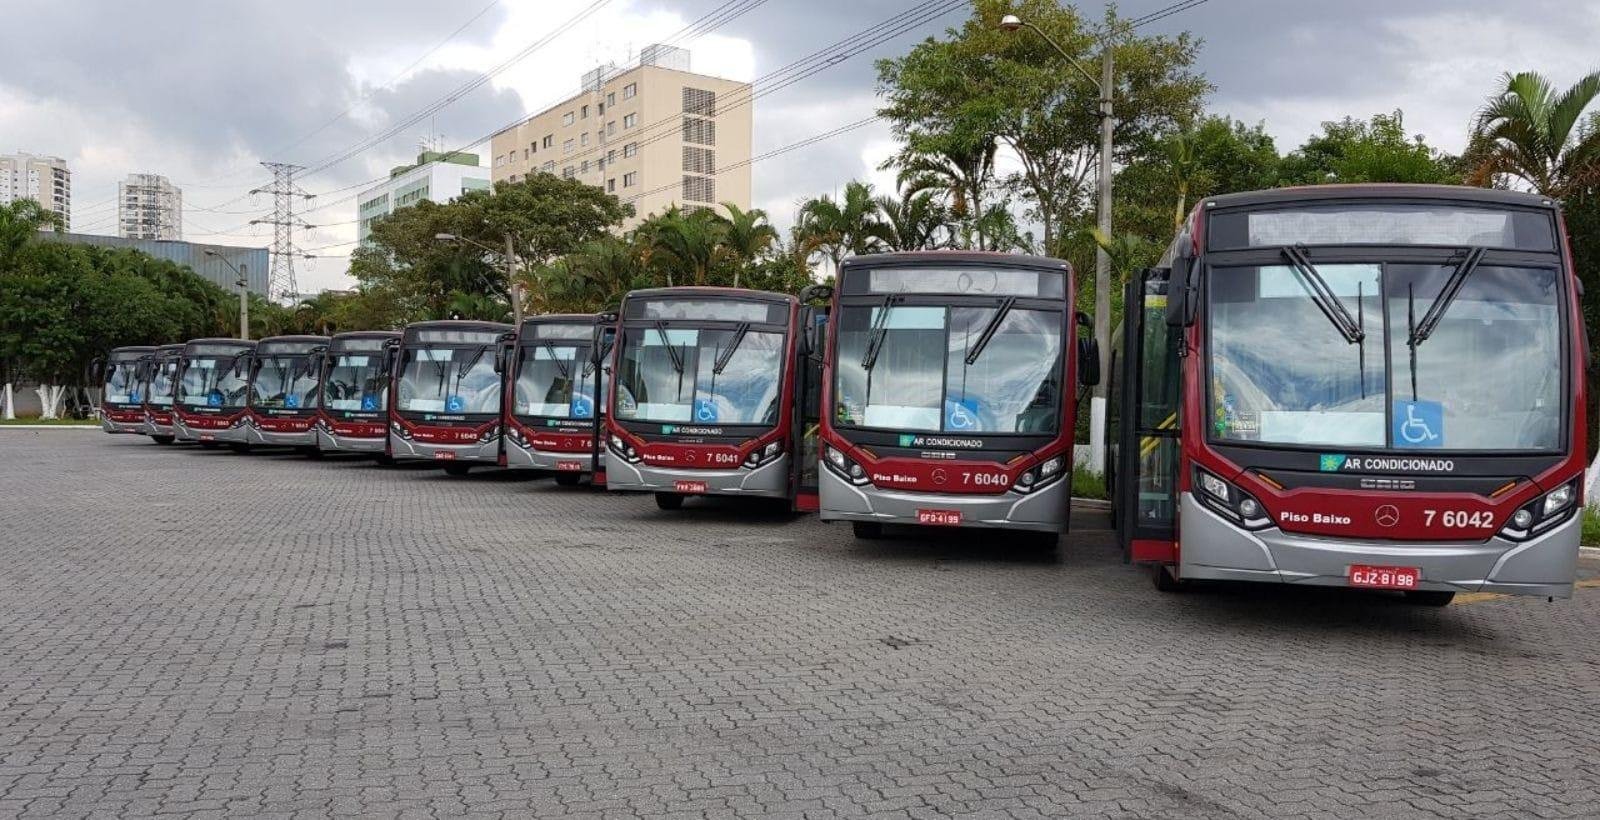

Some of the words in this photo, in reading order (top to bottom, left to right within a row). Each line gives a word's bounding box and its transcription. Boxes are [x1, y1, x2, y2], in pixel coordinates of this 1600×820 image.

[913, 438, 924, 446] AR
[926, 438, 982, 448] CONDICIONADO
[706, 453, 713, 462] 7
[715, 453, 738, 463] 6041
[1344, 458, 1361, 469] AR
[1364, 458, 1454, 471] CONDICIONADO
[873, 473, 891, 481] Piso
[893, 474, 917, 483] Baixo
[962, 473, 971, 484] 7
[974, 473, 1009, 486] 6040
[1280, 511, 1309, 523] Piso
[1313, 513, 1351, 525] Baixo
[1423, 510, 1437, 527] 7
[1443, 510, 1494, 529] 6042
